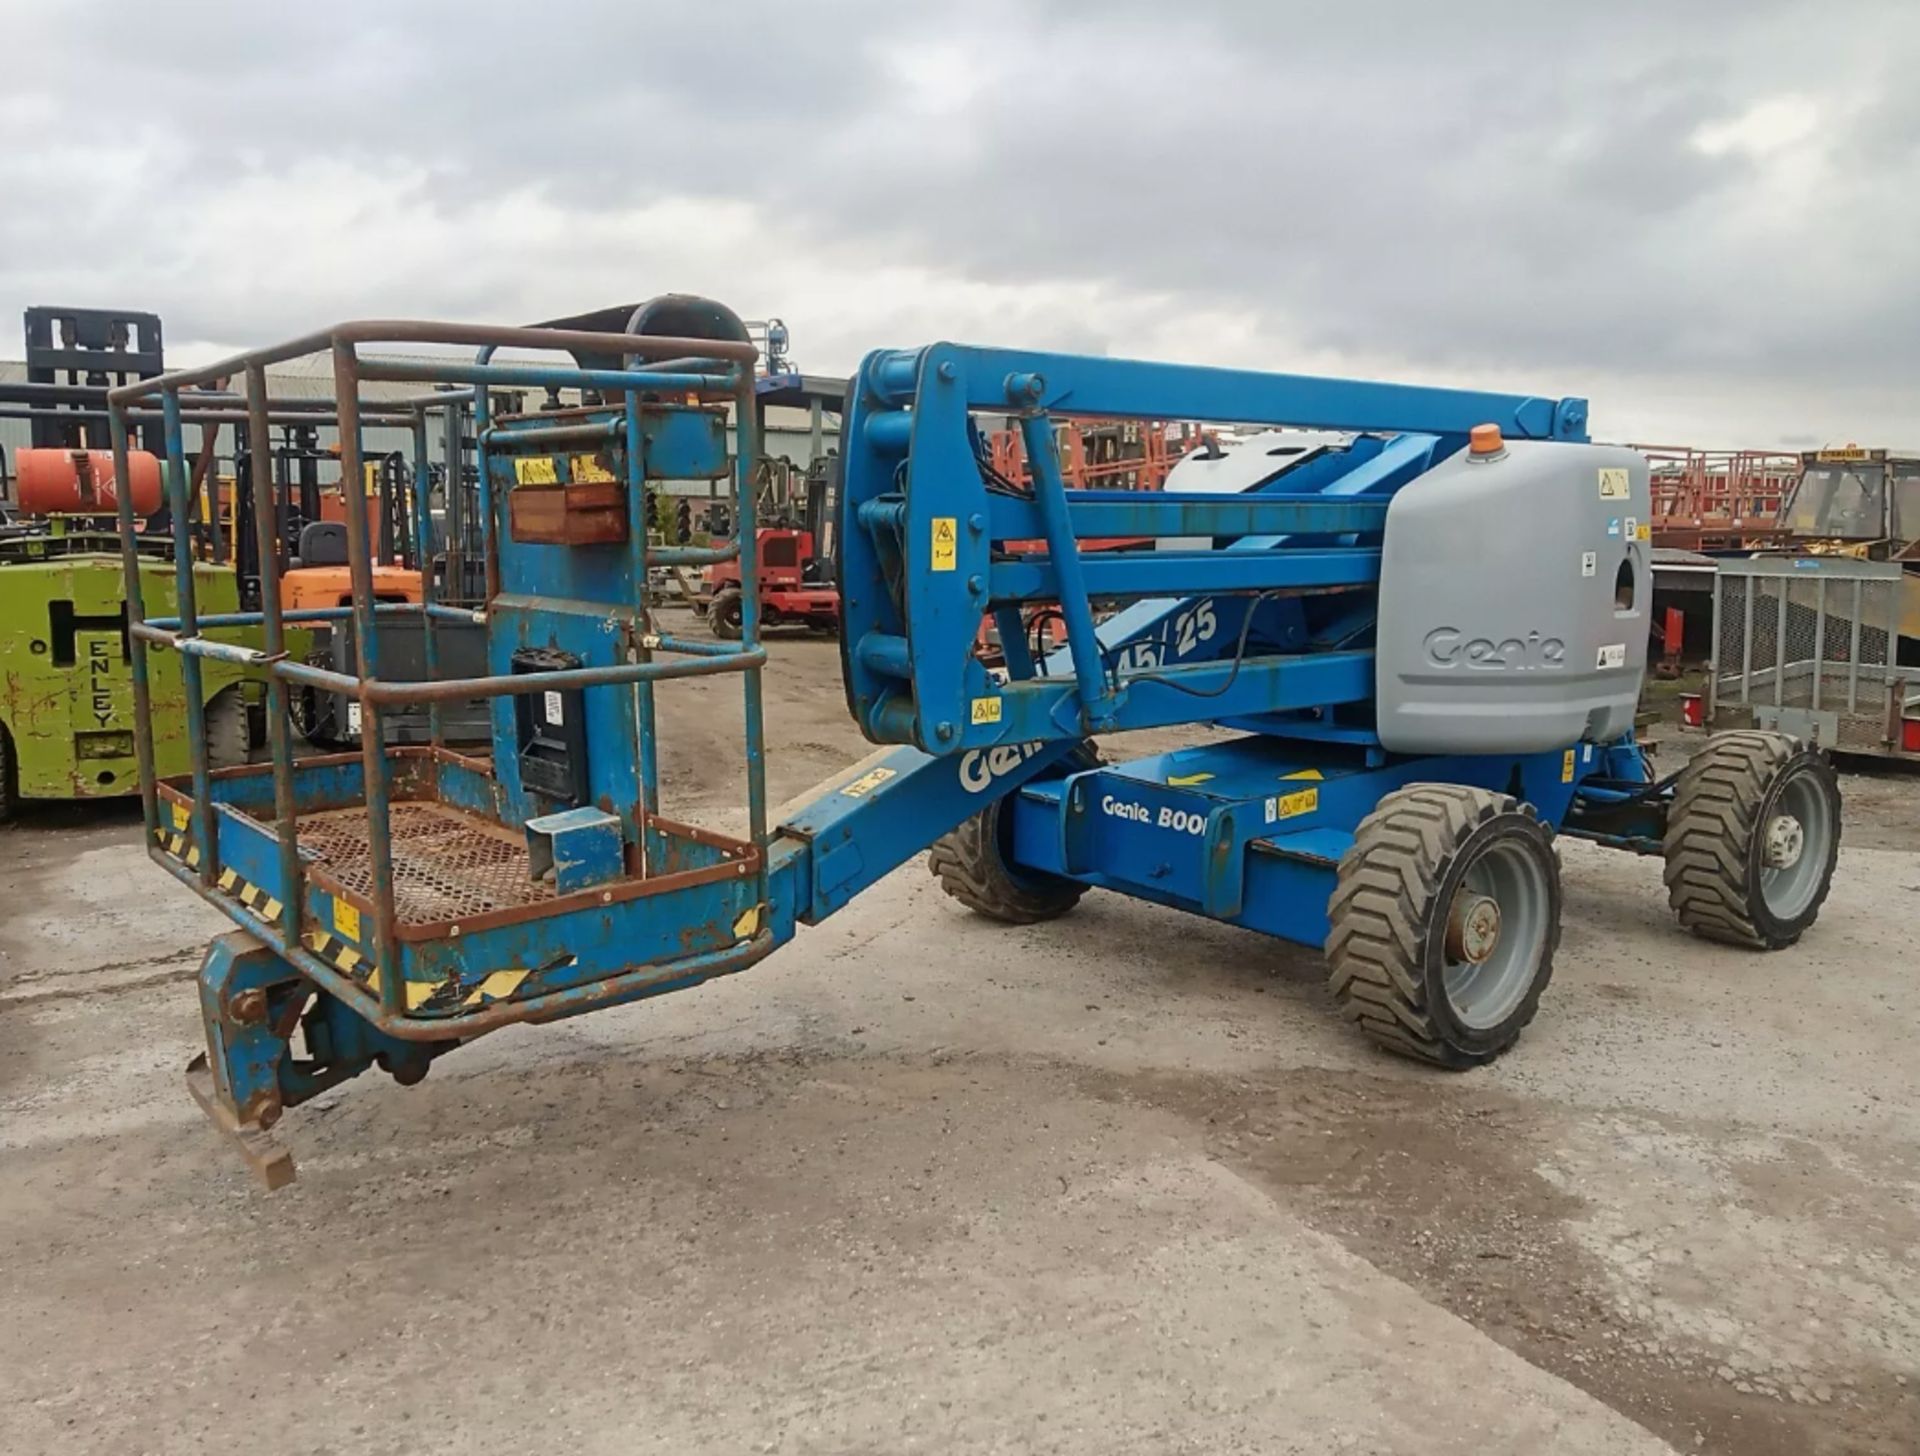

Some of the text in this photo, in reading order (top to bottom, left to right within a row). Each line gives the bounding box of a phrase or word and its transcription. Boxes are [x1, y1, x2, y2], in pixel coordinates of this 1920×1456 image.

[1422, 626, 1566, 670] Genie
[1102, 795, 1208, 836] Genie BOO
